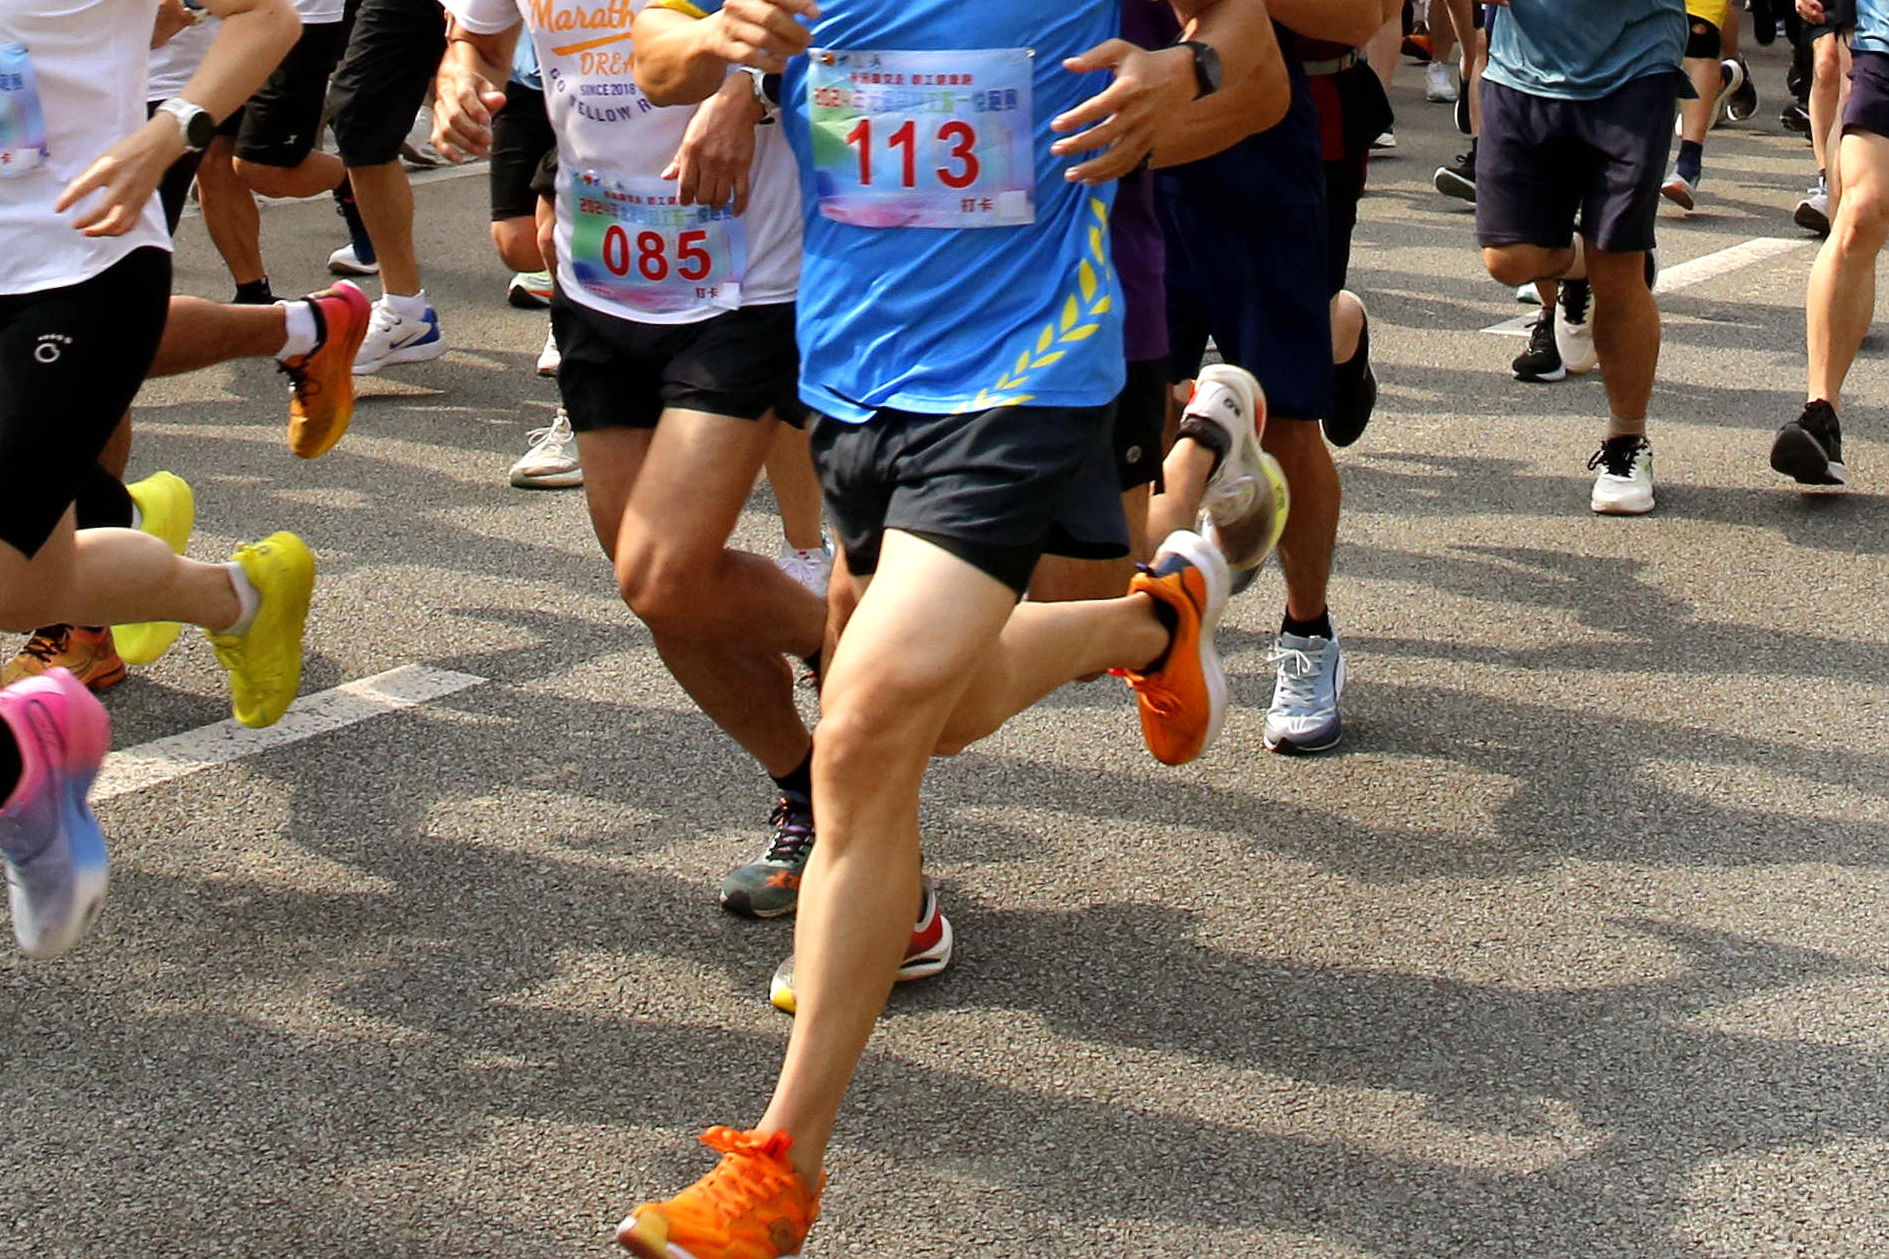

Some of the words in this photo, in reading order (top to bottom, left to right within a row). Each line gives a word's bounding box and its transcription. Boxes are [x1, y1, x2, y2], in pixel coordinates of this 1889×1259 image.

[846, 118, 980, 189] 113
[961, 198, 993, 213] 打卡
[602, 224, 713, 282] 085
